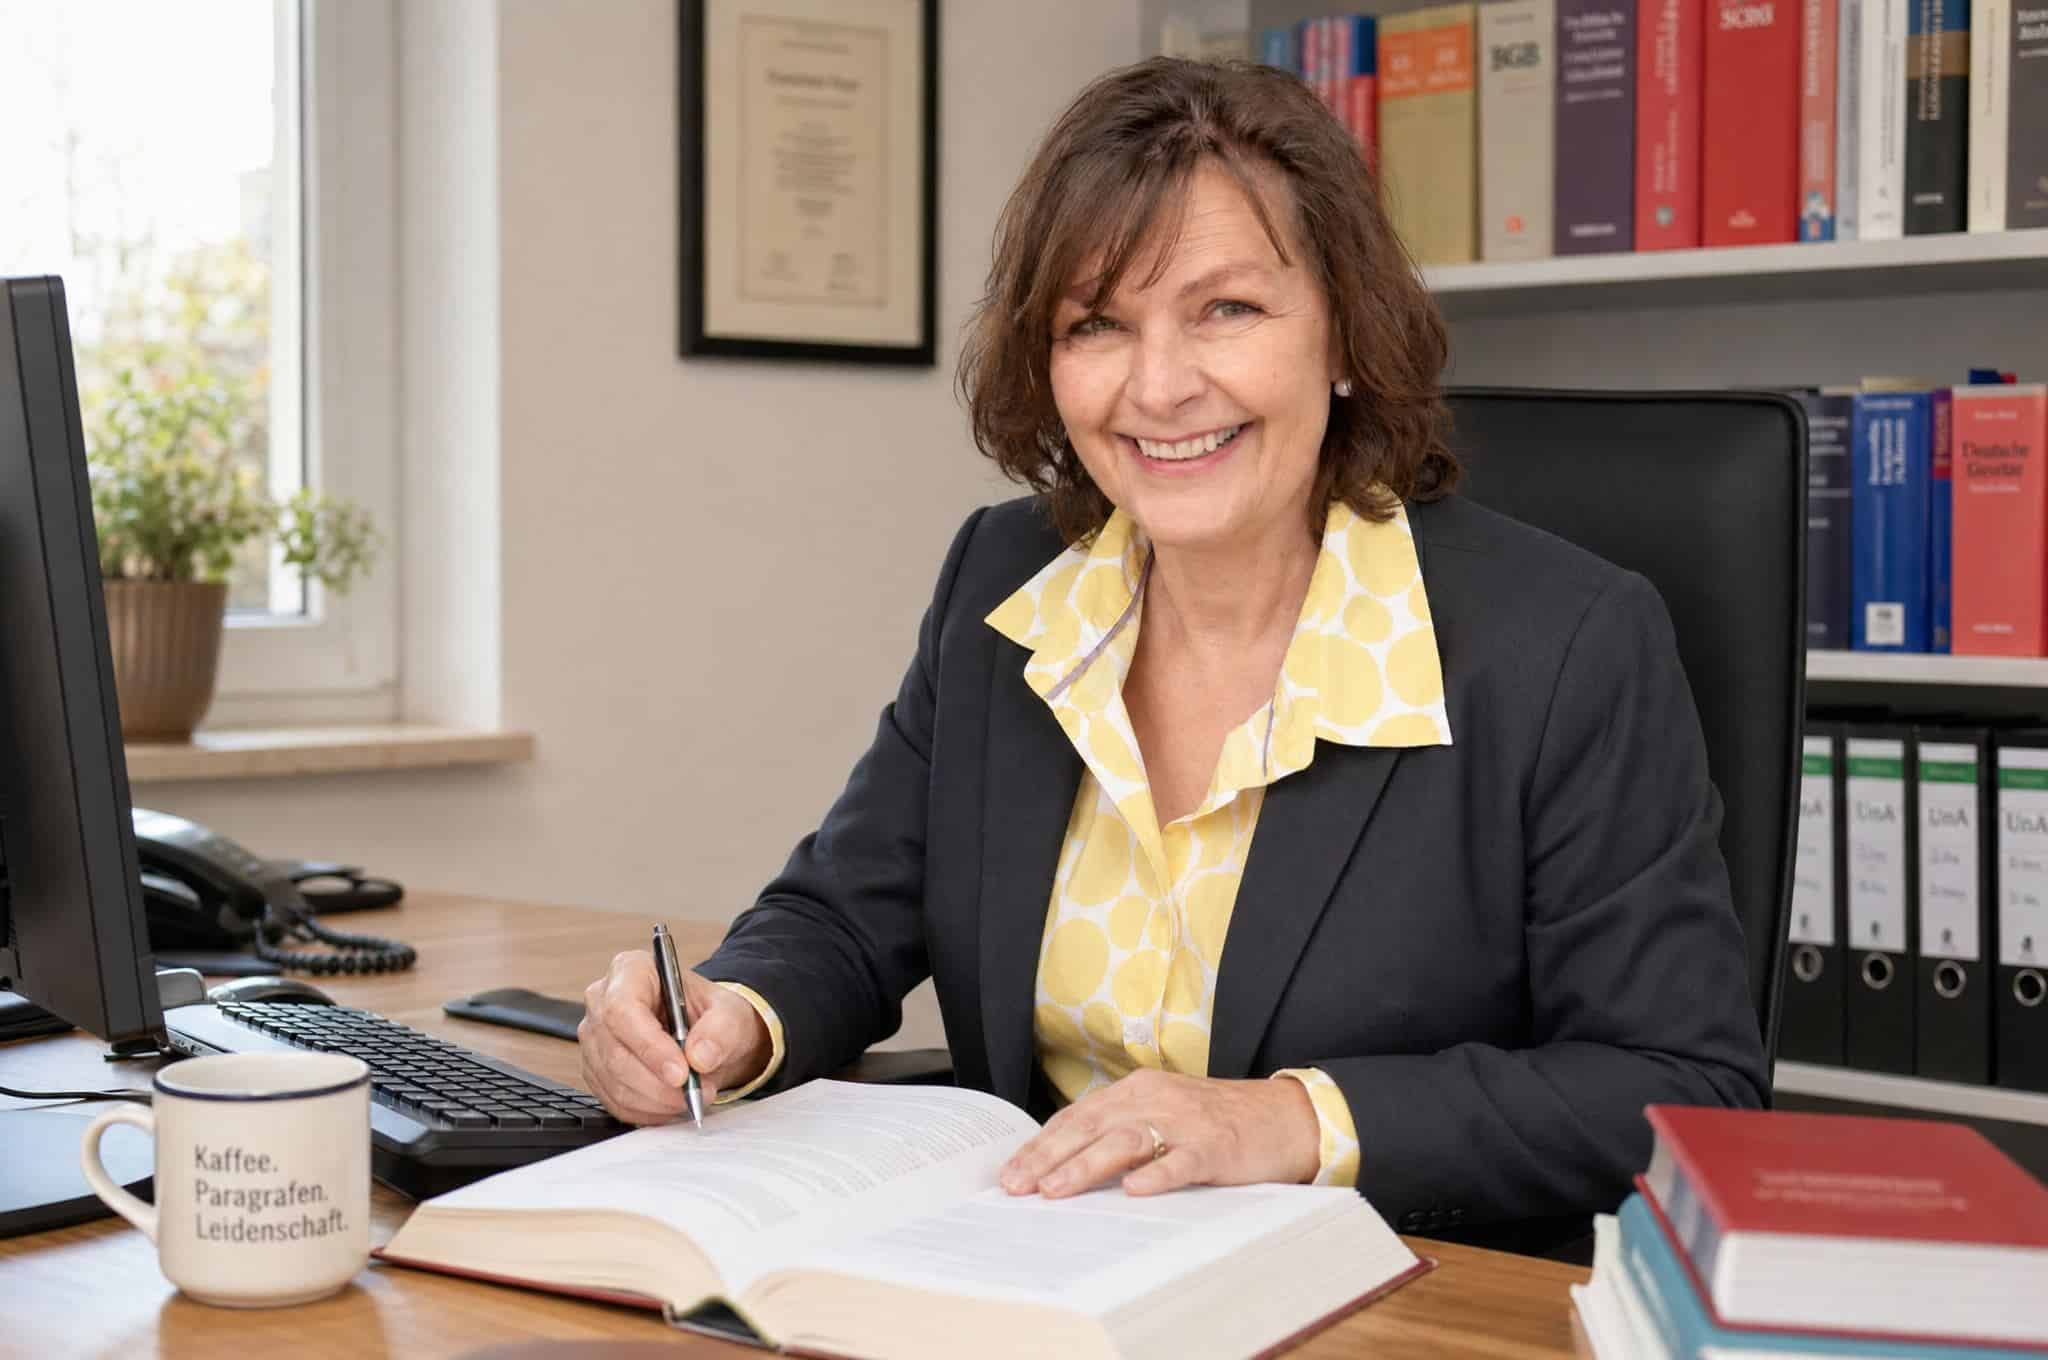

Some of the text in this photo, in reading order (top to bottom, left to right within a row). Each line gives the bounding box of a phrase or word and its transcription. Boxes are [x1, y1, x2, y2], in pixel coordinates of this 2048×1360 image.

[194, 1144, 279, 1174] Kaffee.
[194, 1178, 329, 1214] Paragrafen.
[195, 1207, 349, 1243] Leidenschaft.
